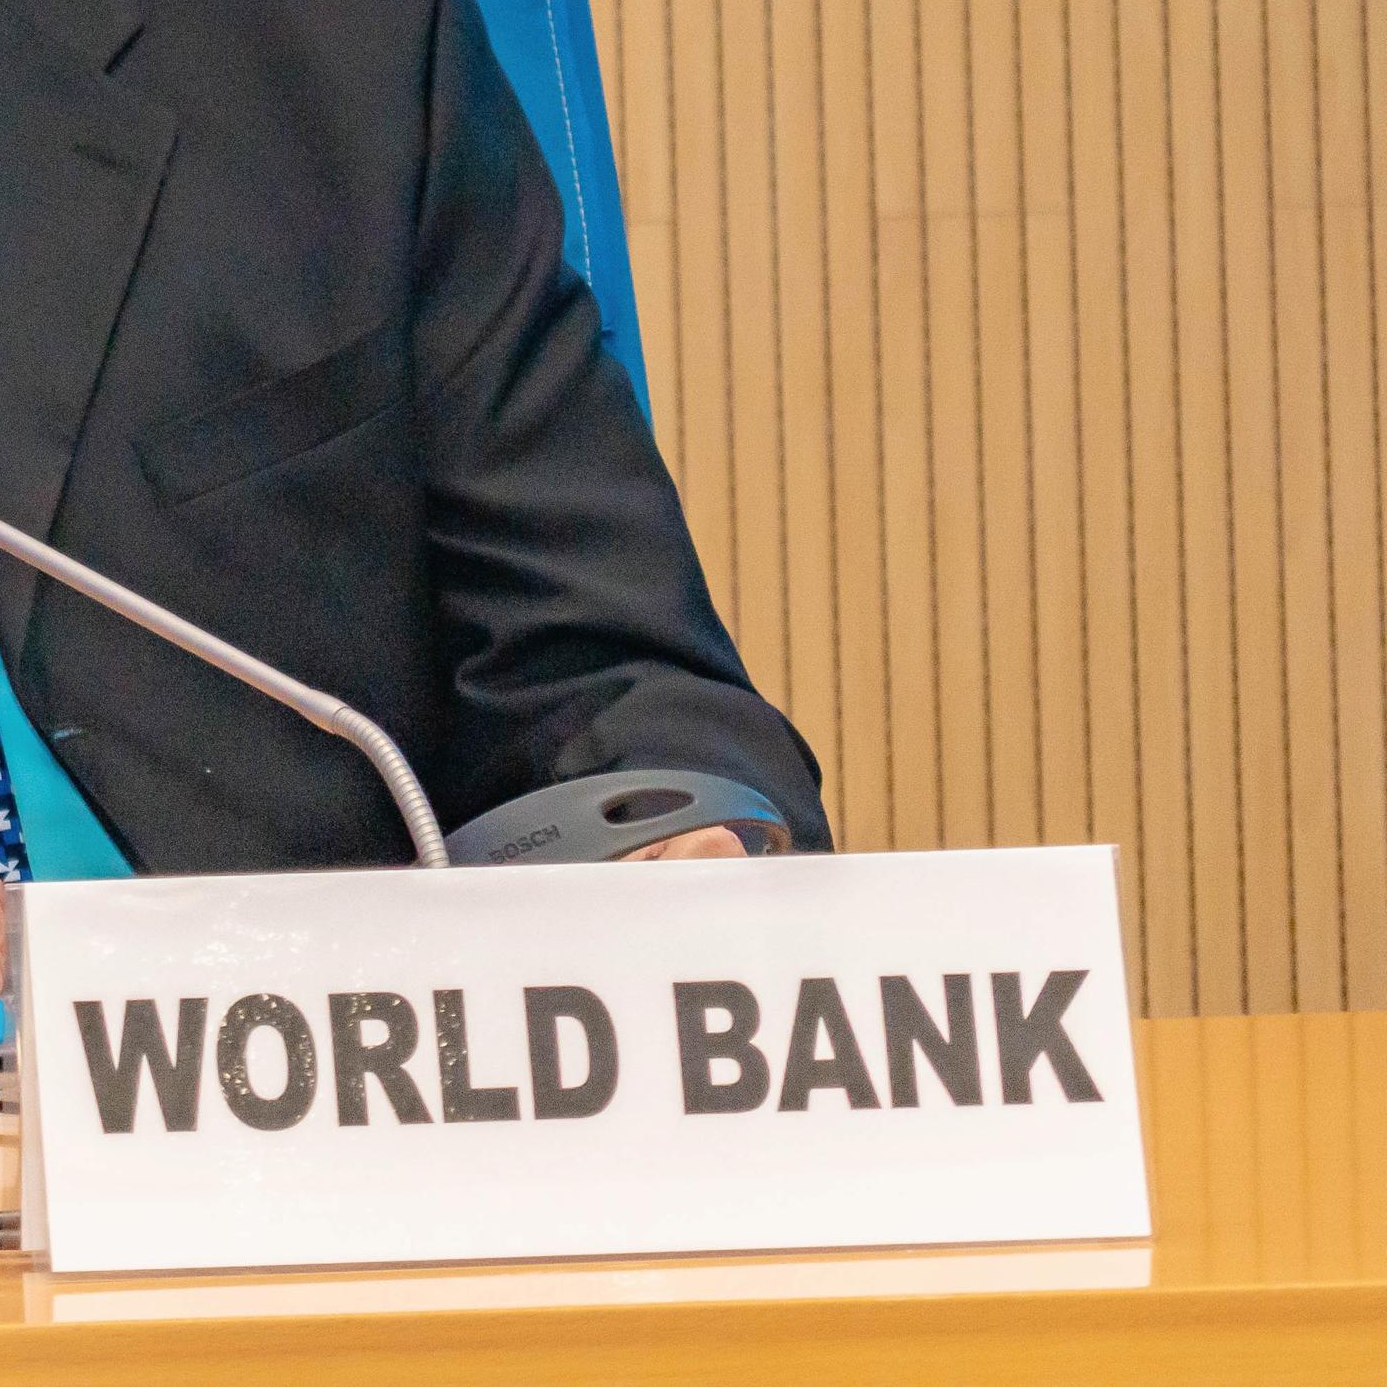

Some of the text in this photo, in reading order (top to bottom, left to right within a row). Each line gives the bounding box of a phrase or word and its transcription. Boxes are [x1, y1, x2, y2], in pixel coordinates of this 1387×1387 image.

[488, 825, 561, 864] BOSCH
[73, 969, 1105, 1133] WORLD BANK
